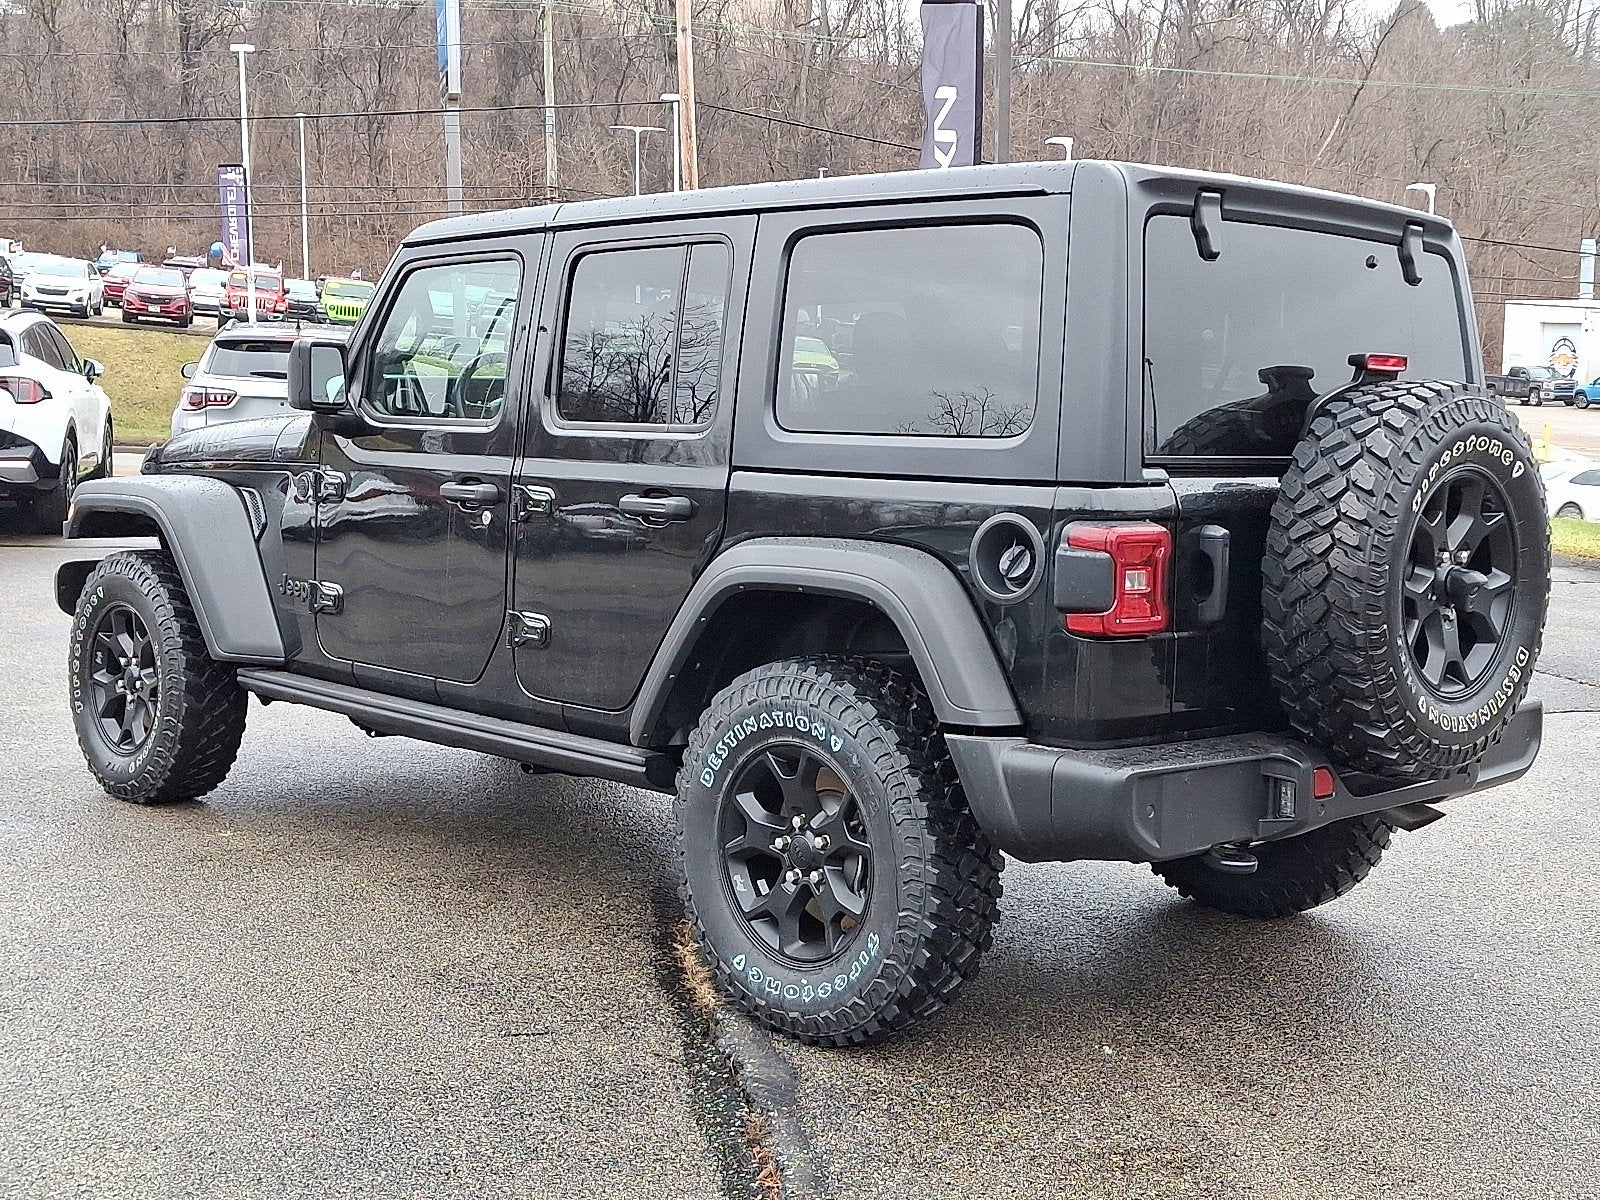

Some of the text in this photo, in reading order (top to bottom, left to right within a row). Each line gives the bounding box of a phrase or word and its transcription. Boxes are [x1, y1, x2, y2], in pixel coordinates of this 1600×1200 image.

[1412, 434, 1514, 513] Firestone
[278, 573, 309, 602] Jeep
[73, 594, 98, 713] Firestone
[1428, 645, 1530, 733] DESTINATION
[700, 711, 826, 788] DESTINATION
[748, 932, 880, 1002] Firestone
